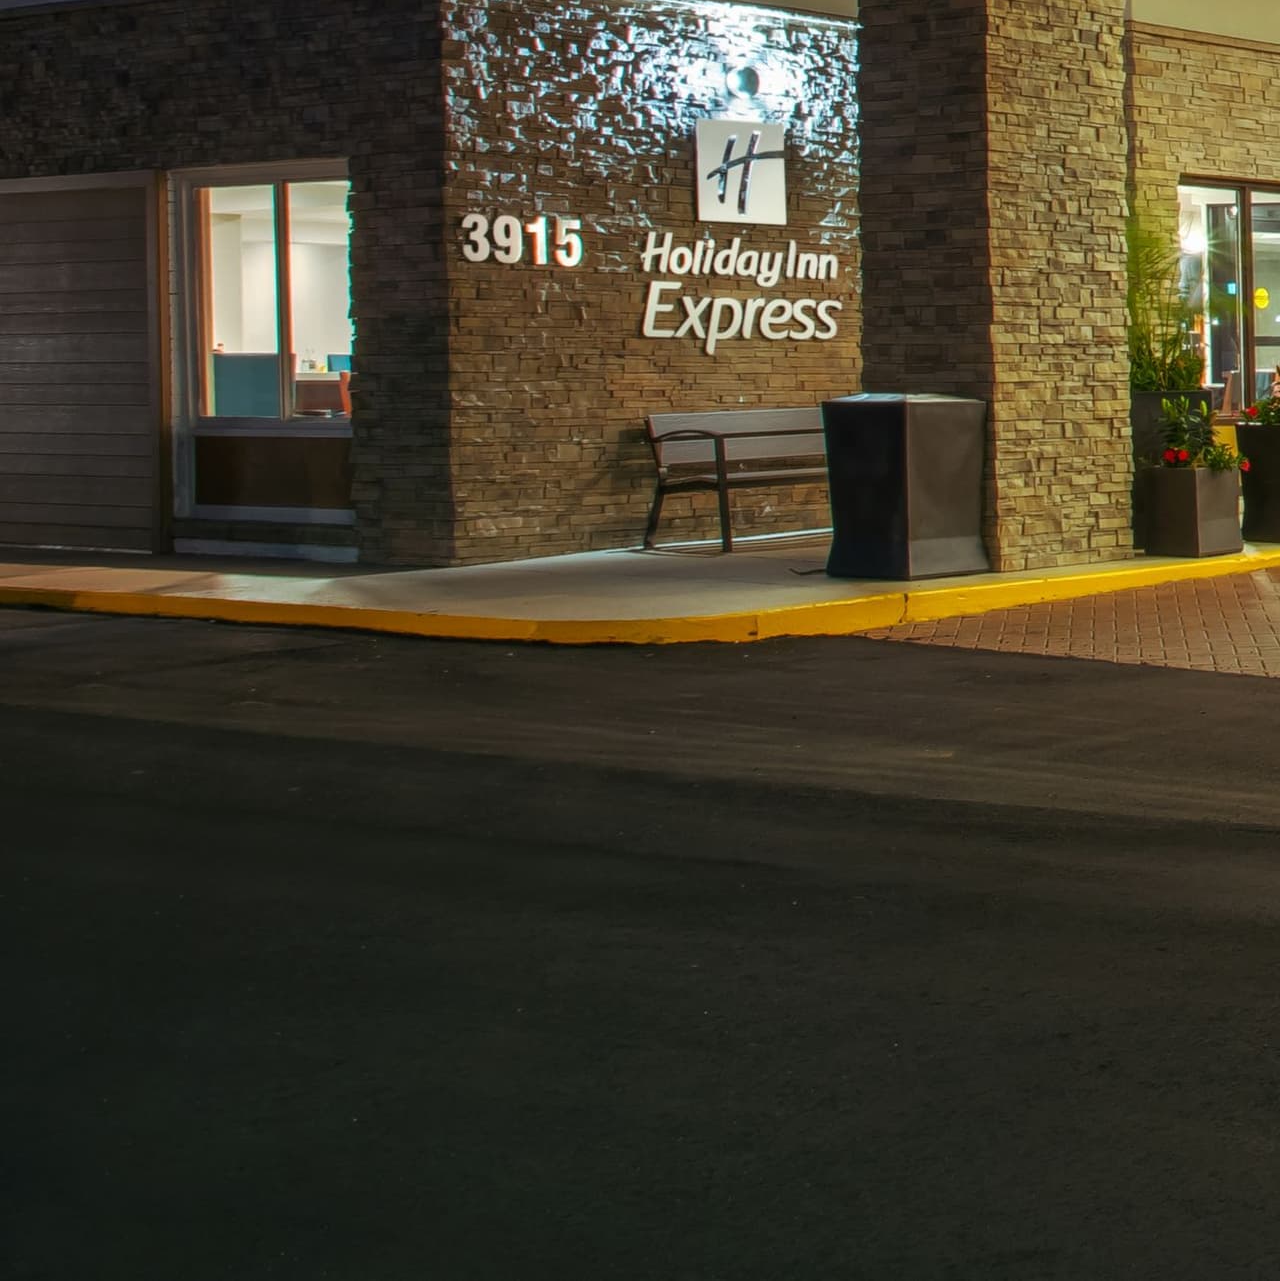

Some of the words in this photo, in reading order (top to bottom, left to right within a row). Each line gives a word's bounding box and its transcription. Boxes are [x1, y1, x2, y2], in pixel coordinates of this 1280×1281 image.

[461, 213, 584, 267] 3915
[640, 231, 784, 287] Holiday
[785, 239, 839, 280] Inn
[642, 280, 843, 356] Express
